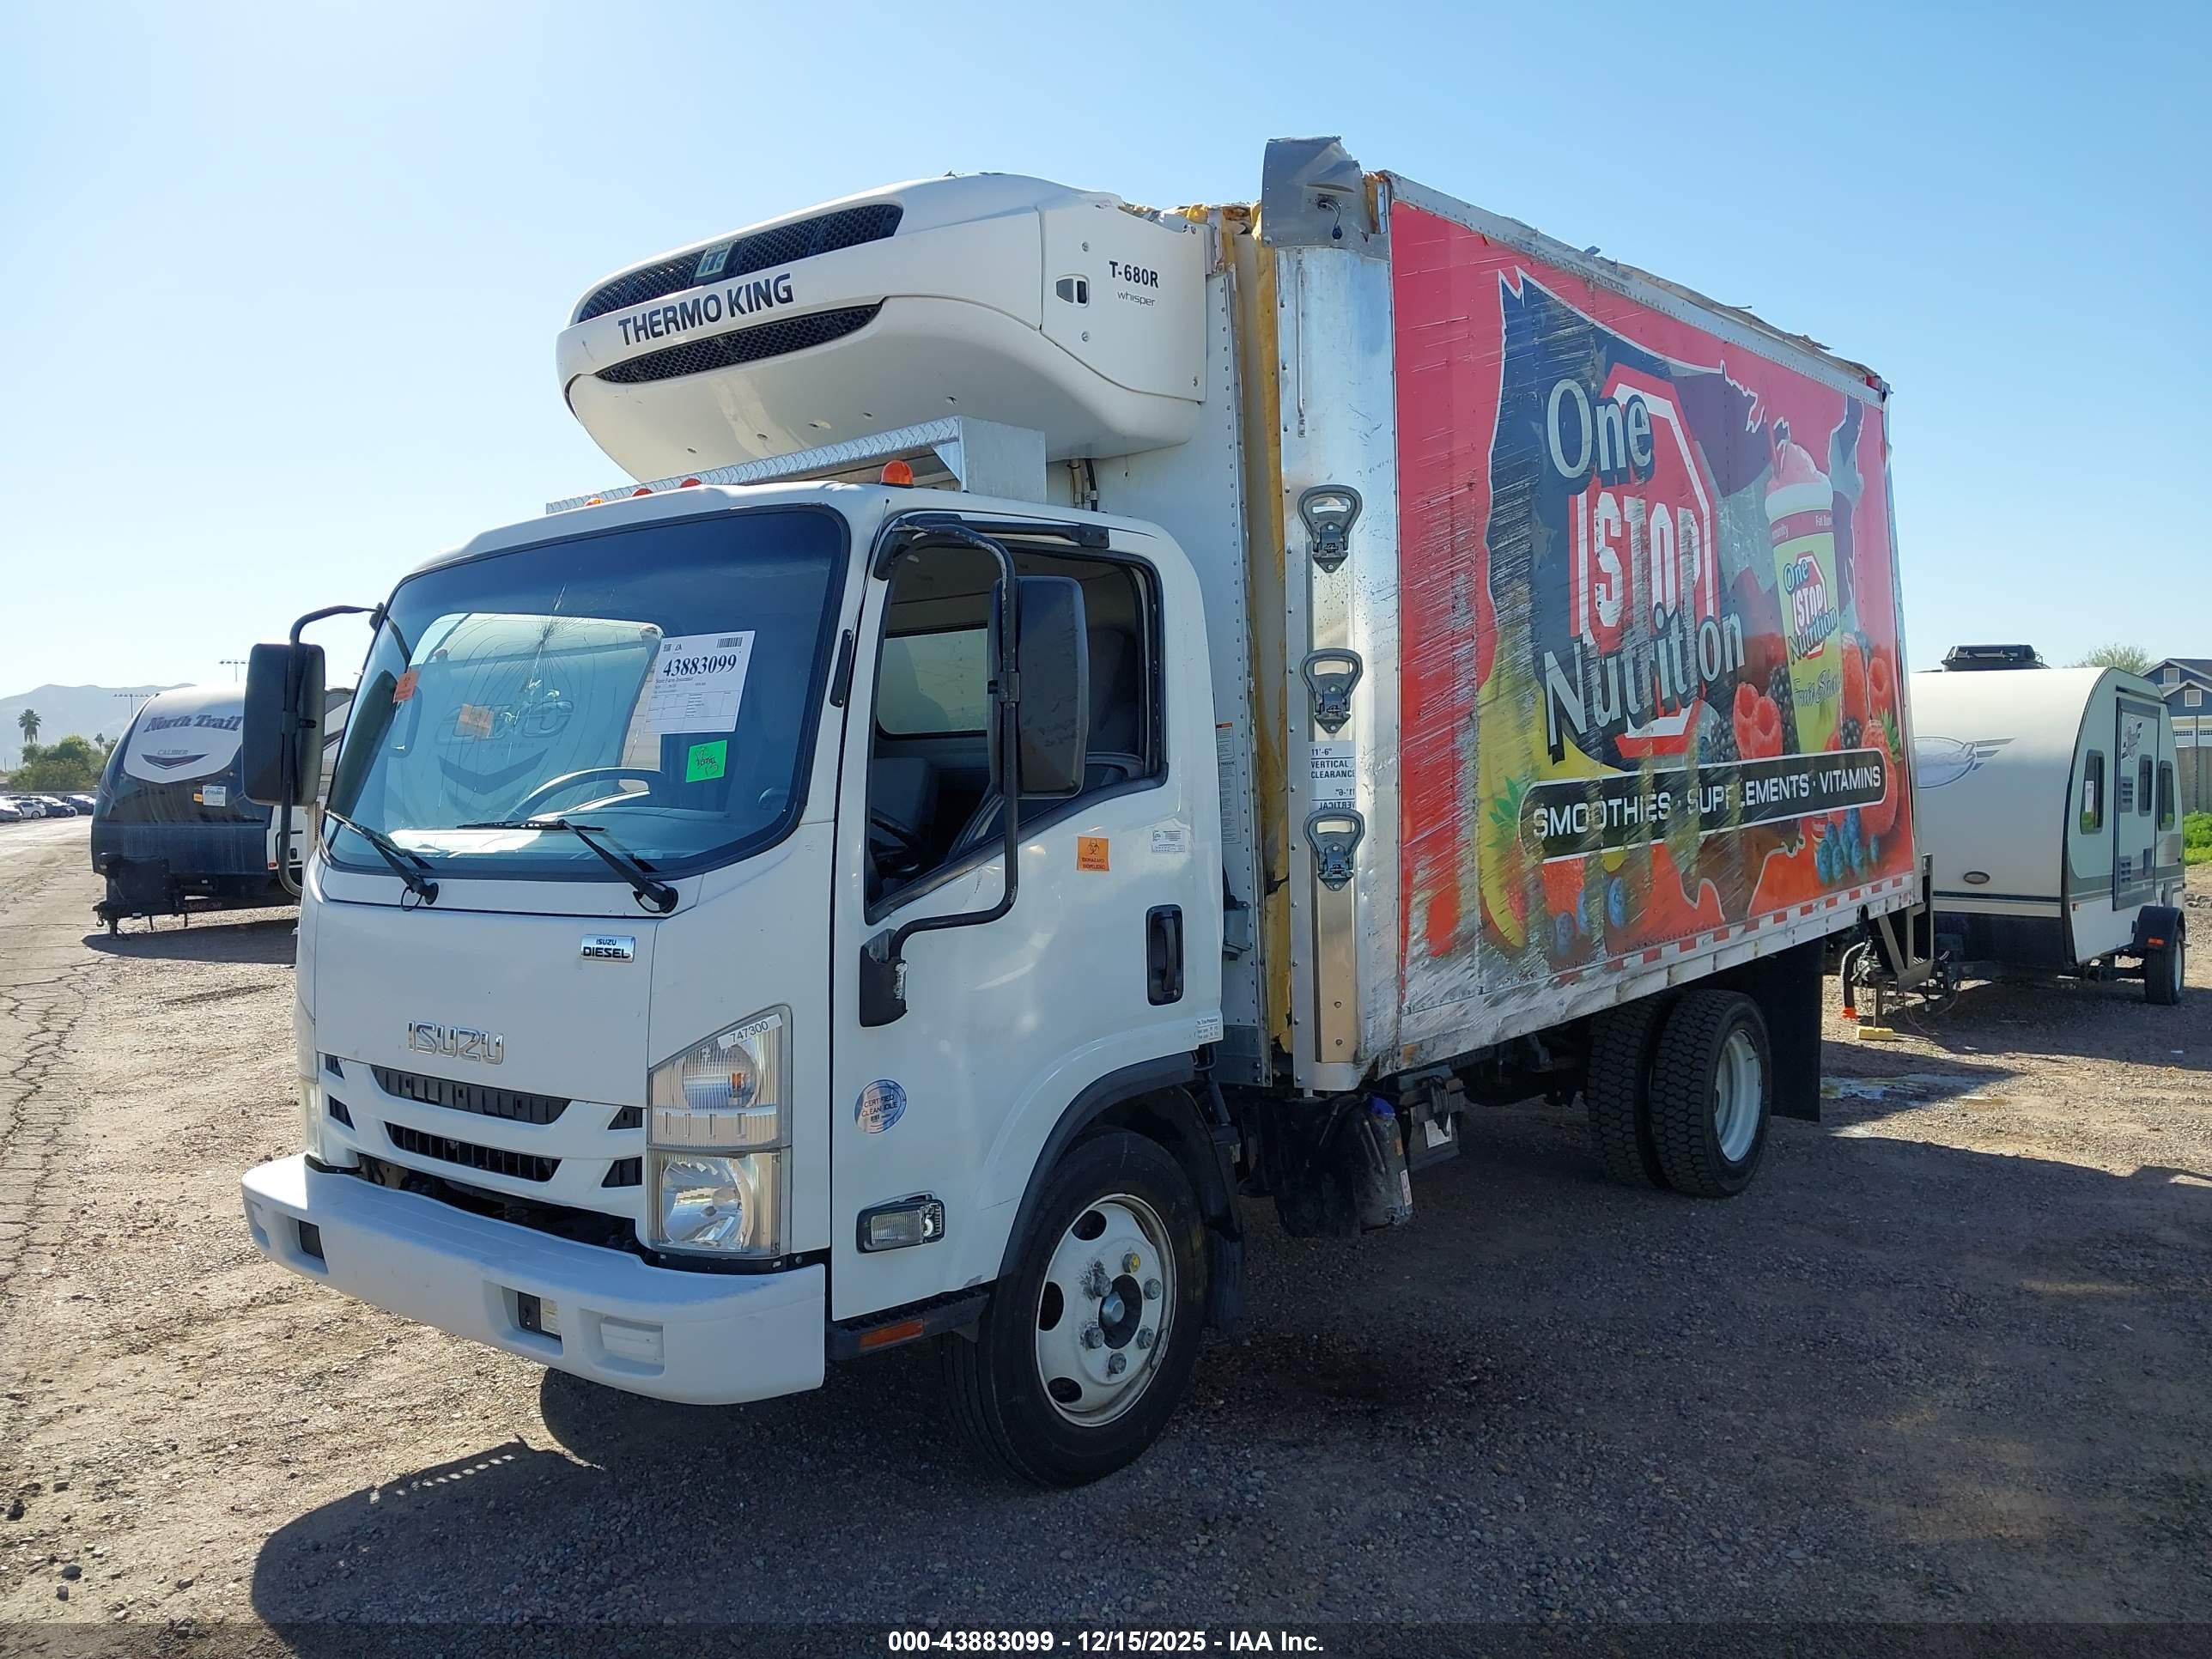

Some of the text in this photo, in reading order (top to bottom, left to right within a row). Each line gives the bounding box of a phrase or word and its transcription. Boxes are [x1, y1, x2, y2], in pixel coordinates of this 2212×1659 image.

[1109, 260, 1158, 289] T-680R
[617, 272, 794, 346] THERMO KING
[1117, 290, 1156, 307] whisper
[1547, 378, 1652, 479] One
[1593, 491, 1700, 630] STOP
[1784, 559, 1808, 592] One
[1796, 583, 1824, 627] STOP
[1788, 606, 1838, 666] Nutrition
[663, 653, 737, 677] 43883099
[143, 714, 243, 733] North Trail
[1310, 760, 1349, 769] VERTICAL
[1533, 791, 1671, 840] SMOOTHIES
[1819, 765, 1881, 794] VITAMINS
[583, 946, 631, 959] DIESEL
[596, 938, 617, 946] ISUZU
[407, 1019, 505, 1066] ISUZU
[729, 1020, 769, 1043] 747300
[862, 1101, 898, 1117] CLEAN IDLE
